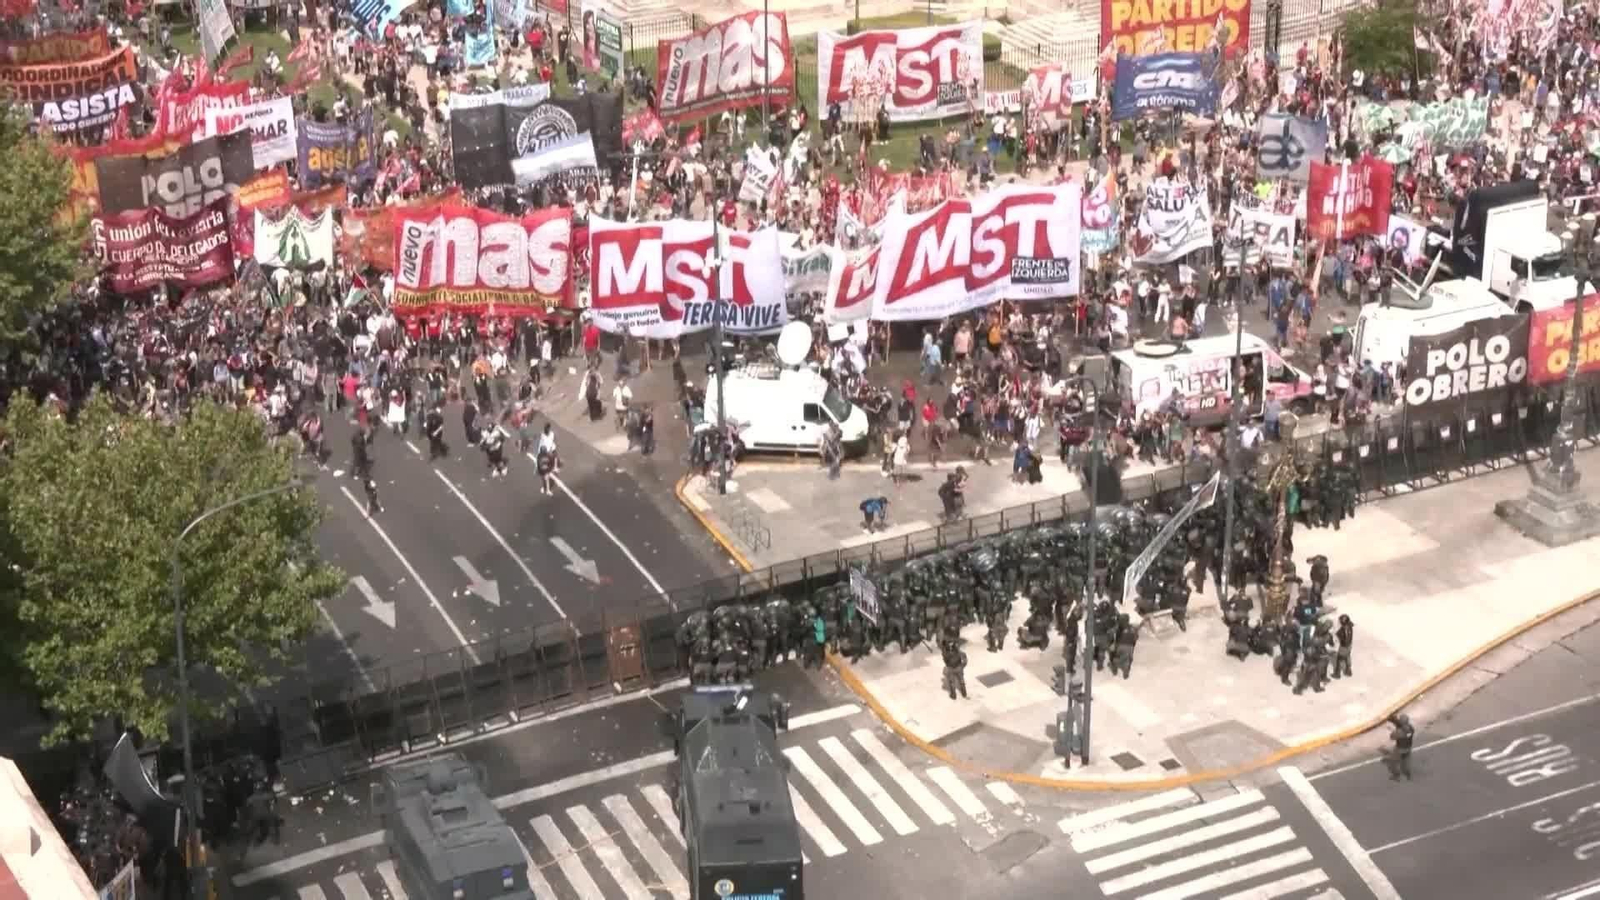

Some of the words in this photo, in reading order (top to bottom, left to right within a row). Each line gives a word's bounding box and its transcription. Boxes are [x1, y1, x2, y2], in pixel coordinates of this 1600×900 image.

[1117, 18, 1239, 54] ORERO
[661, 14, 785, 108] mas
[665, 47, 683, 102] nuevo
[42, 83, 136, 121] ASISTA
[141, 157, 224, 206] POLO
[109, 220, 151, 242] unión
[171, 230, 228, 258] DELEGADOS
[905, 203, 1054, 286] MST
[398, 214, 571, 294] mas
[403, 226, 422, 283] nuevo
[598, 237, 750, 312] MST
[1011, 258, 1053, 269] FRENTE
[1011, 266, 1068, 278] IZQUIERDA
[743, 303, 781, 327] VIVE
[1426, 335, 1510, 377] POLO
[1406, 356, 1527, 406] OBRERO
